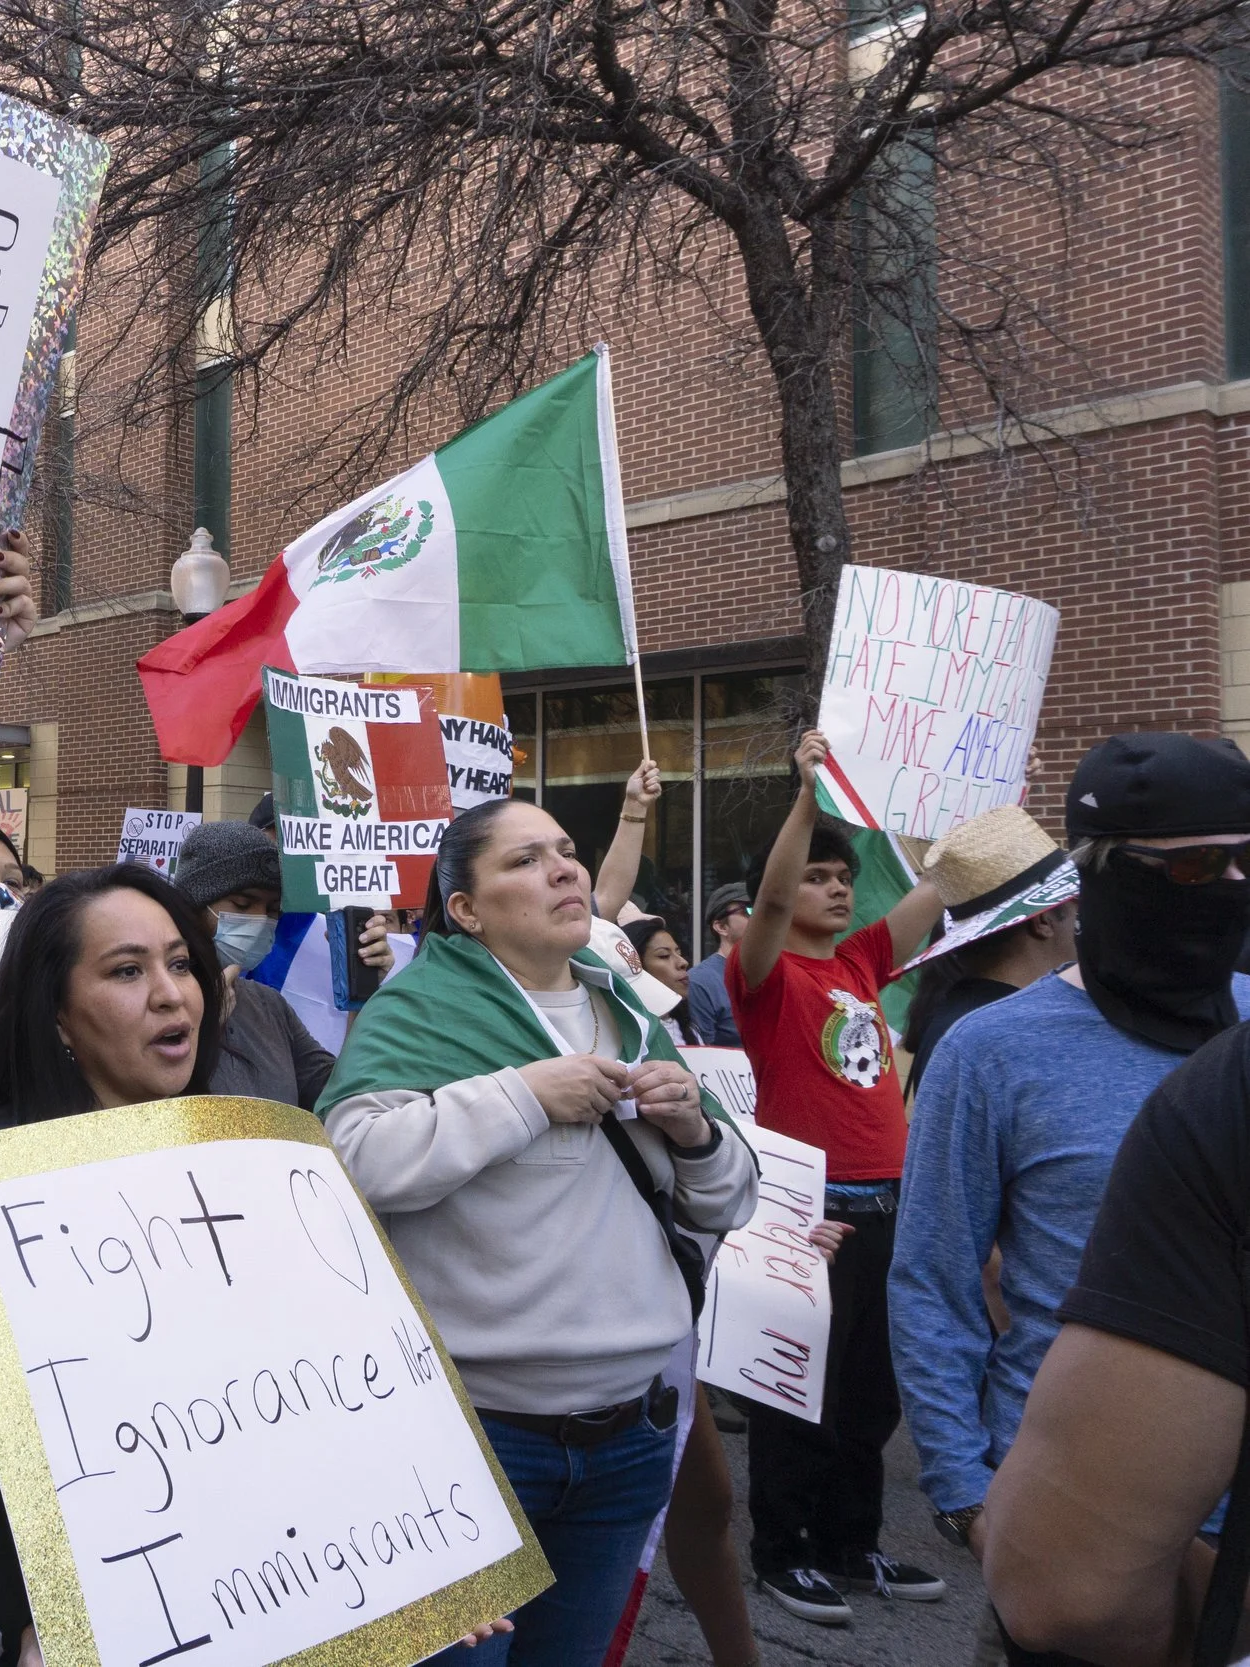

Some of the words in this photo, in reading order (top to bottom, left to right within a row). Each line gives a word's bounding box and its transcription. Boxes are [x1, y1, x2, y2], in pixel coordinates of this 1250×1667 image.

[844, 568, 900, 636] NO
[907, 578, 993, 655] MORE
[271, 677, 402, 719] IMMIGRANTS
[857, 694, 947, 770] MAKE
[145, 812, 184, 830] STOP
[282, 823, 332, 850] MAKE
[340, 822, 446, 851] AMERICA
[884, 766, 991, 839] GREAT
[323, 864, 393, 893] GREAT
[0, 1171, 244, 1343] Fight
[26, 1352, 395, 1514] Ignorance
[391, 1316, 441, 1387] Not
[101, 1465, 481, 1667] Immigrants
